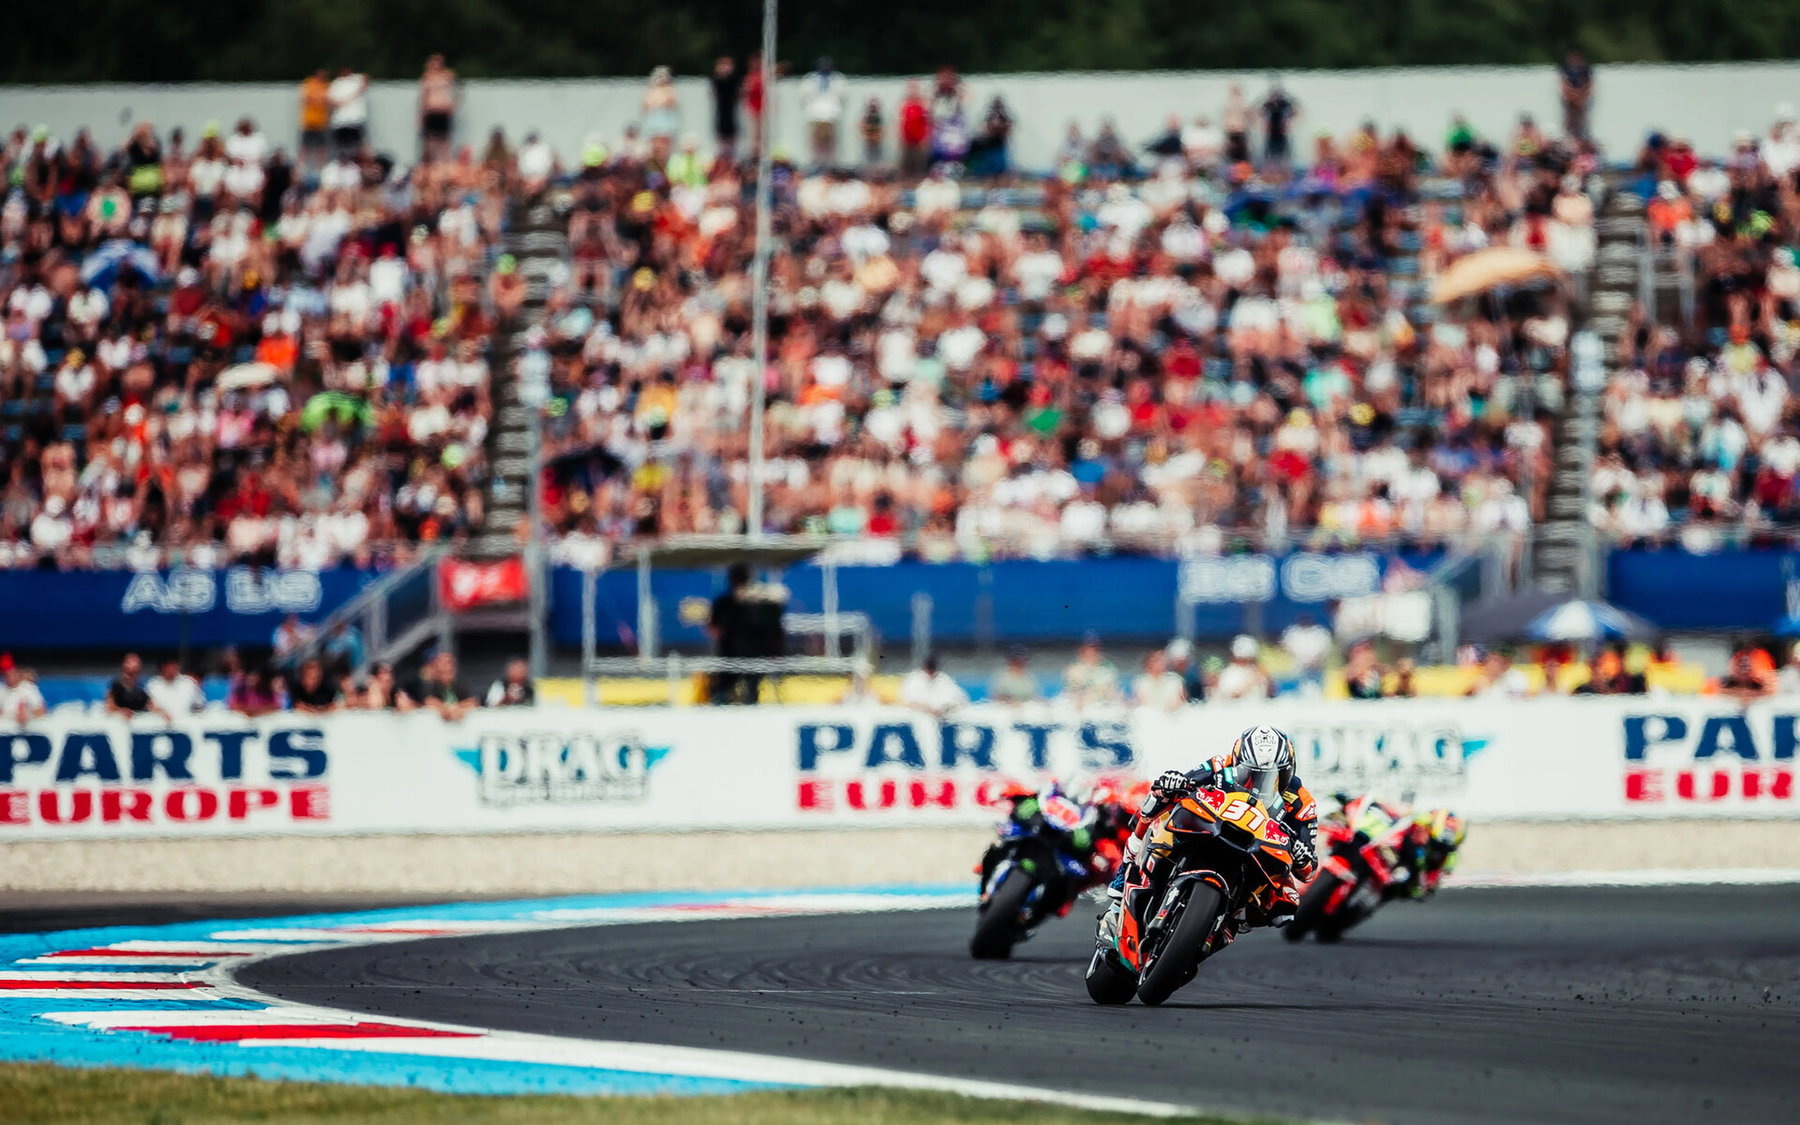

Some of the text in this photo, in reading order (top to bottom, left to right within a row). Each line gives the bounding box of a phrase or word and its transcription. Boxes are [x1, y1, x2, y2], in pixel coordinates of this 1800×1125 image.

[0, 730, 328, 782] PARTS
[481, 733, 649, 783] DRAG
[796, 722, 1136, 769] PARTS
[0, 788, 331, 822] EUROPE
